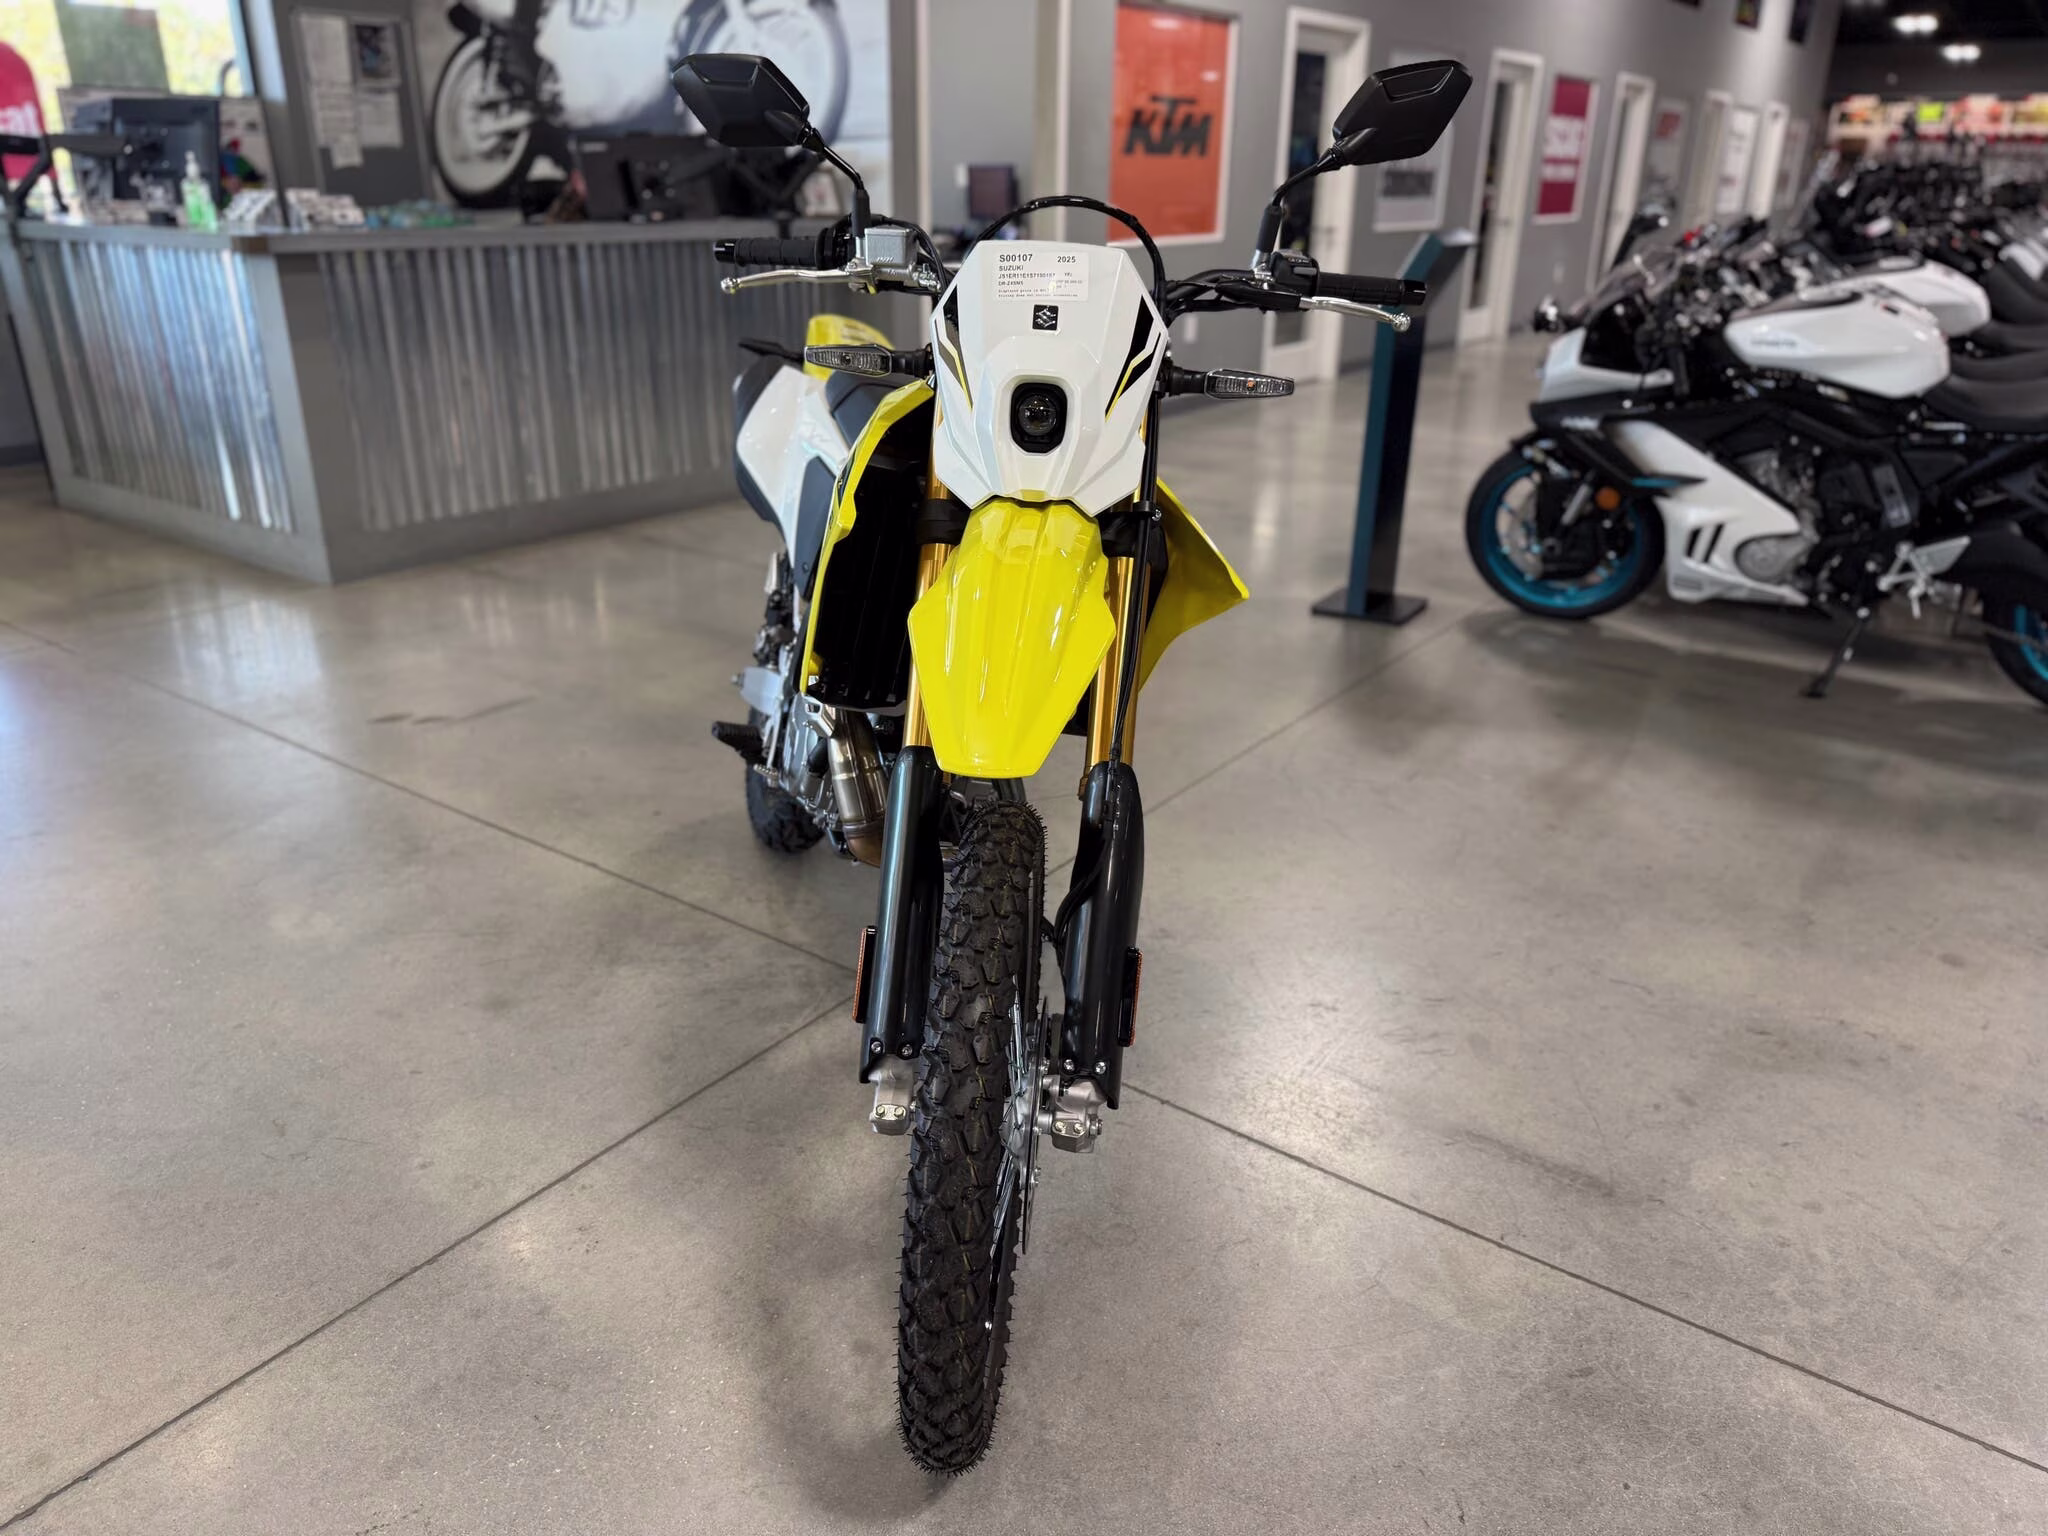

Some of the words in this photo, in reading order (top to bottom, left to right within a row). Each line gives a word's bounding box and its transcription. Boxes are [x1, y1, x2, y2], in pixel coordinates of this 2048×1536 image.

[1123, 95, 1212, 156] KTM
[999, 254, 1033, 262] S00107
[1057, 255, 1076, 263] 2025
